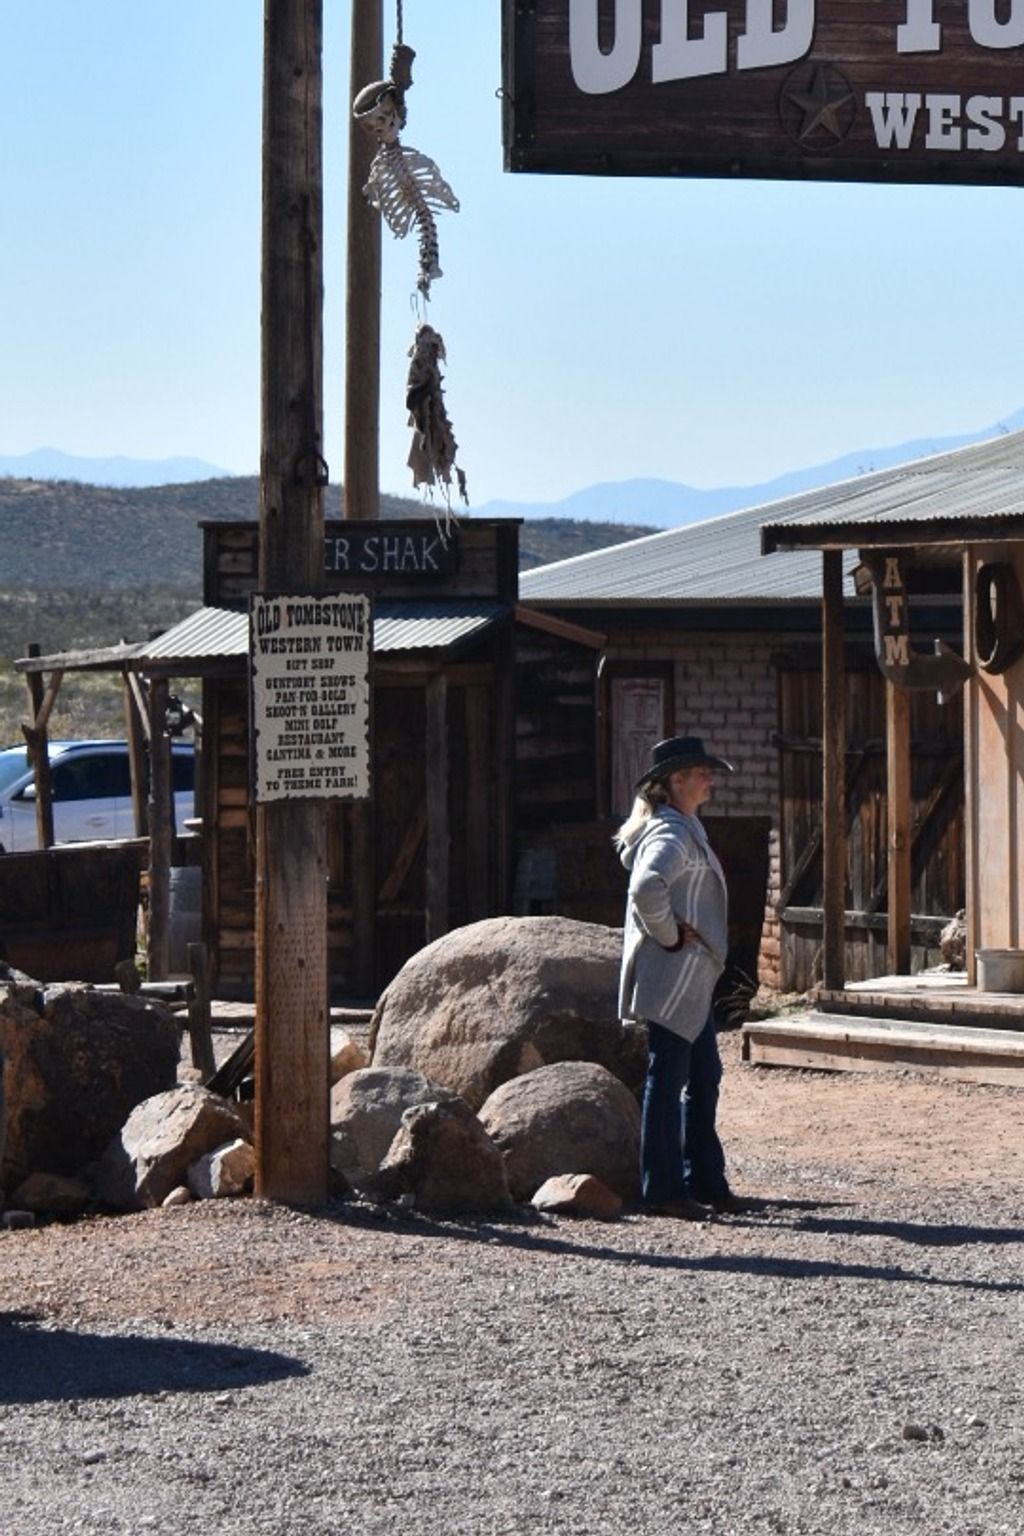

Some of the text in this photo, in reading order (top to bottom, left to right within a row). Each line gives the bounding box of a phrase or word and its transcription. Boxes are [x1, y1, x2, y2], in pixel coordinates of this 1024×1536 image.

[361, 536, 439, 571] SHAK
[883, 557, 910, 666] ATM
[257, 603, 365, 636] OLD TOMBSTONE
[259, 636, 364, 654] WESTERN TOWN
[286, 658, 335, 671] GIFT SHOP
[266, 675, 356, 690] GUNFIGHT SHOWS
[311, 703, 356, 717] GALLERY
[285, 719, 339, 731] MINI GOLF
[278, 733, 345, 746] RESTAURANT
[266, 746, 357, 761] CANTINA & MORE
[277, 766, 346, 779] FREE ENTRY
[266, 780, 279, 791] TO
[284, 778, 321, 790] THEME
